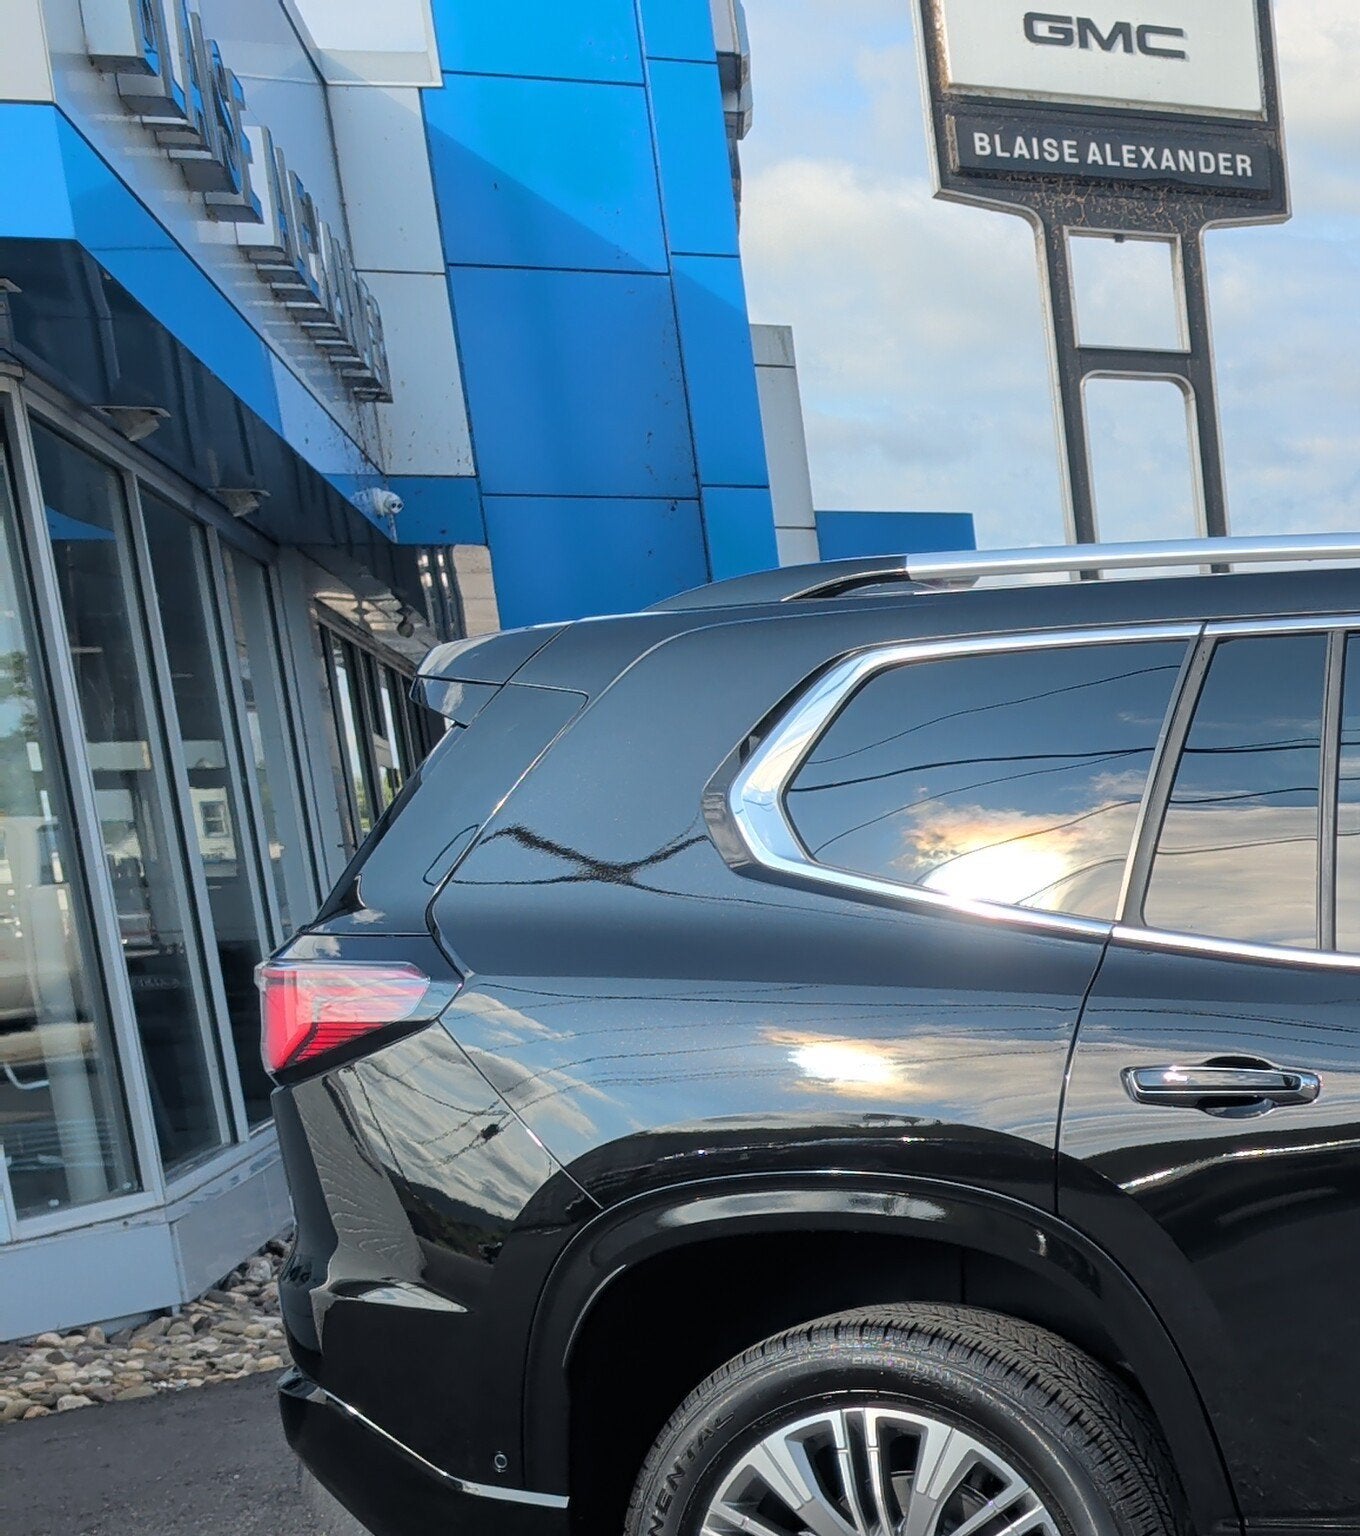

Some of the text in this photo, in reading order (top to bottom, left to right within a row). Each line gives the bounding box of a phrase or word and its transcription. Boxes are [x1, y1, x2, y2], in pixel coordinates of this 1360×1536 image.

[1023, 11, 1187, 60] GMC
[973, 131, 1253, 178] BLAISE ALEXANDER
